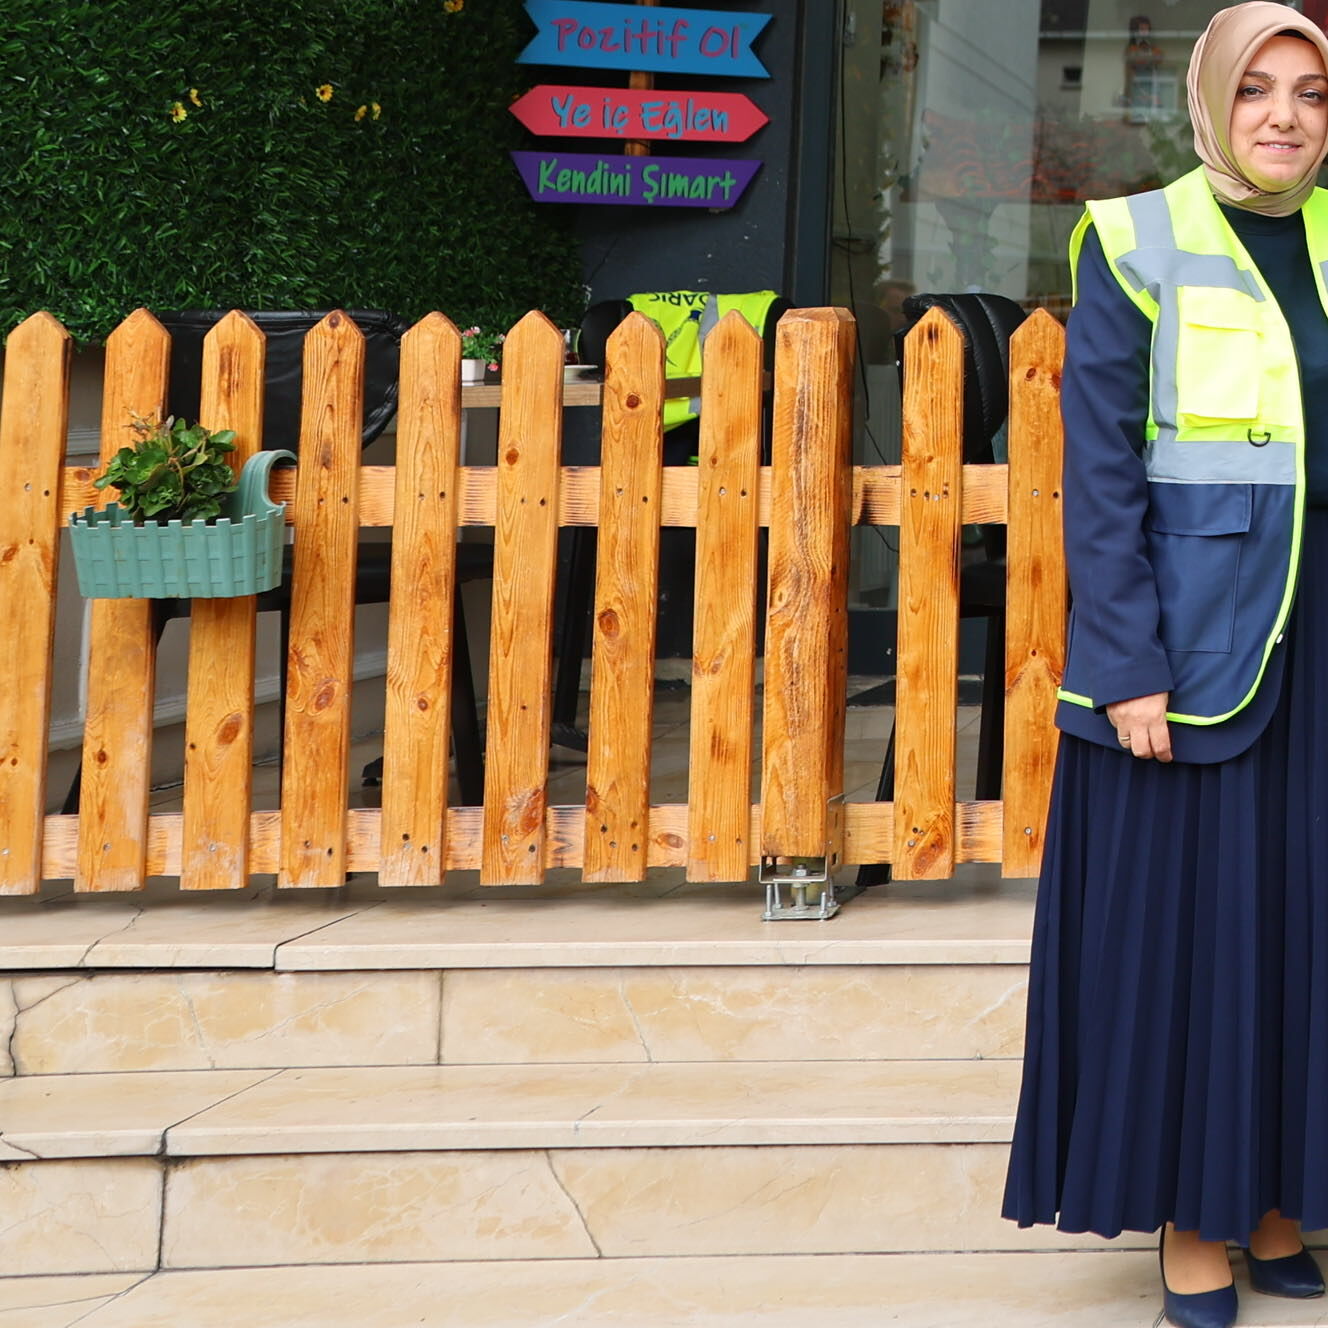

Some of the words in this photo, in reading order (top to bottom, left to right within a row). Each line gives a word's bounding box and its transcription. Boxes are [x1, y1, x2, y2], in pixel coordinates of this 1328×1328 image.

[552, 18, 689, 59] Pozitif
[700, 26, 740, 59] Ol
[551, 94, 592, 128] Ye
[640, 99, 729, 138] Eğlen
[538, 159, 632, 197] Kendini
[642, 165, 736, 204] Şımart
